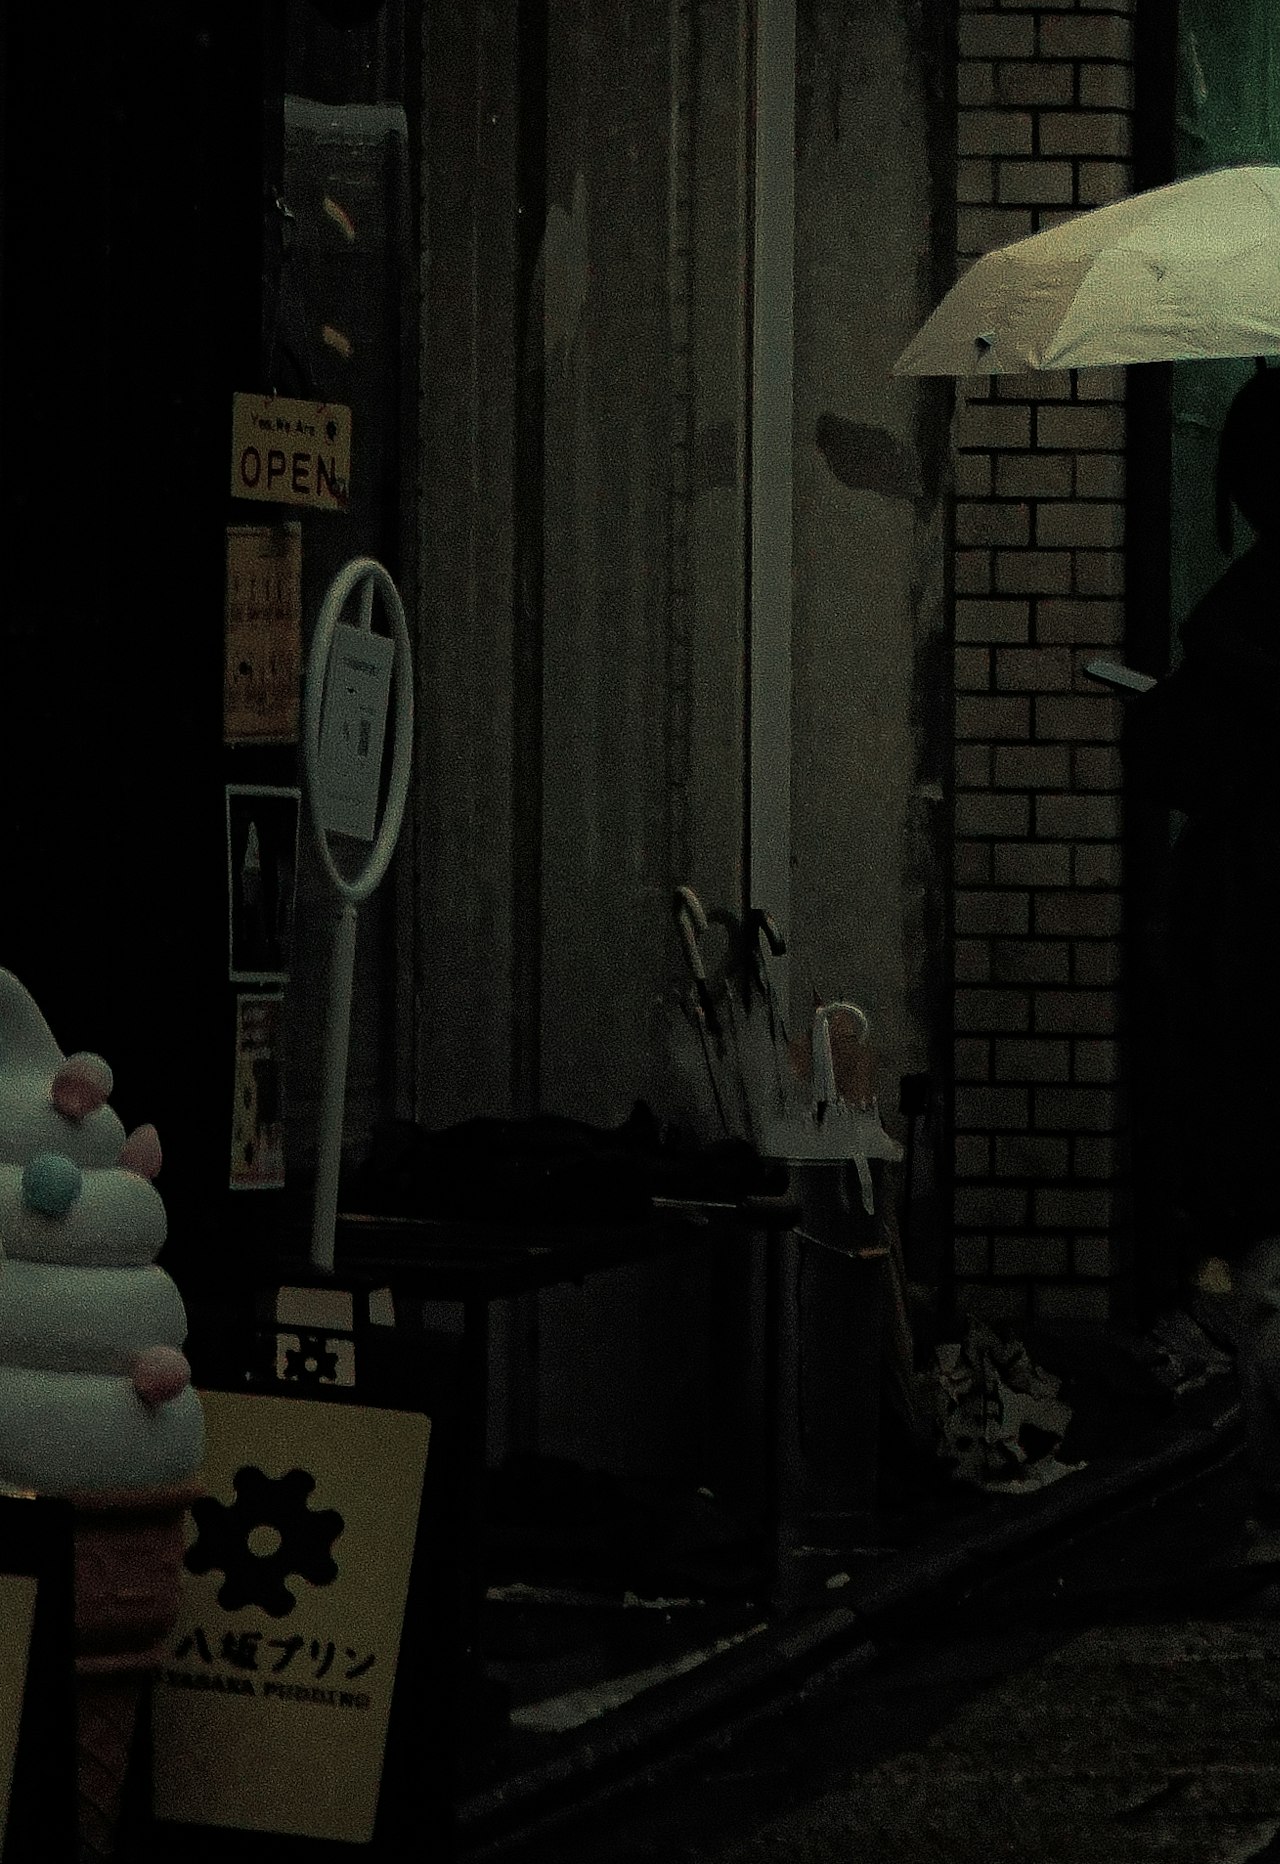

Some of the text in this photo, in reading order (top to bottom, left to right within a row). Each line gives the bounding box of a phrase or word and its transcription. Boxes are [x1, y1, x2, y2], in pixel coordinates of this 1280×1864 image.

[240, 445, 336, 496] OPEN
[175, 1627, 376, 1680] 八坂プリン
